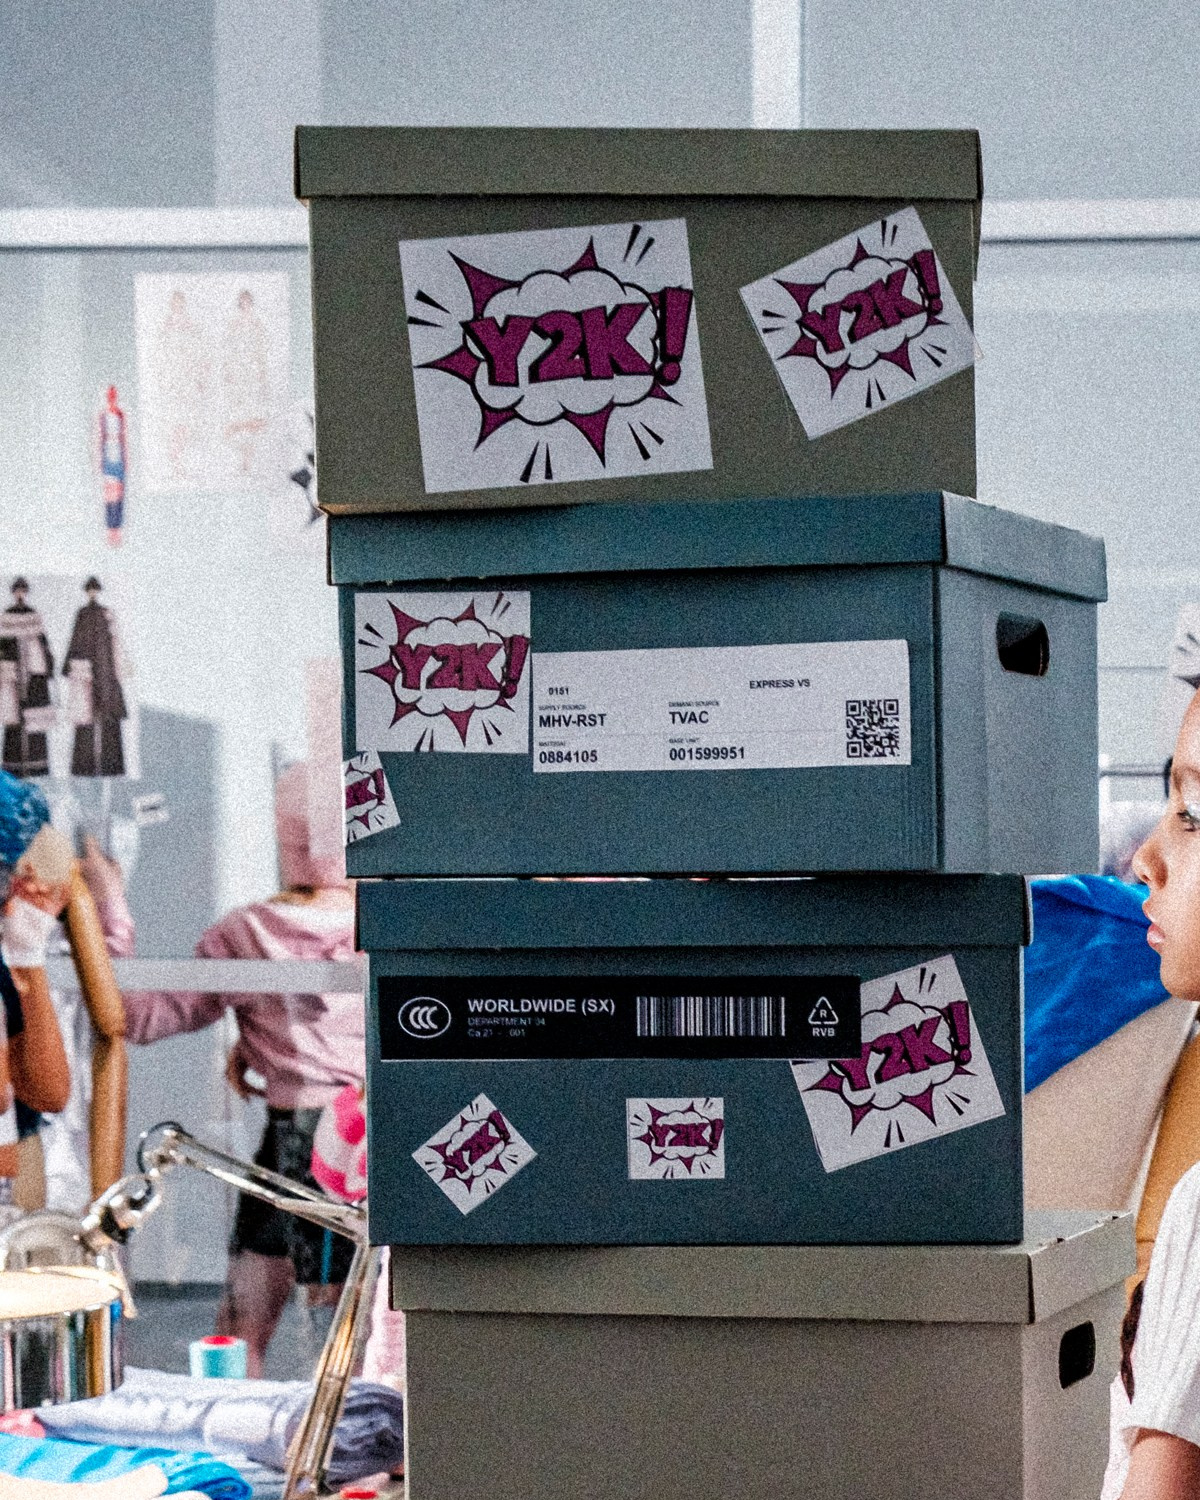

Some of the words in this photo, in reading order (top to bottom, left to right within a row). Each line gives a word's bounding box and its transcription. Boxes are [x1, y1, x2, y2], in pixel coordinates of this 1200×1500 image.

[796, 248, 944, 355] Y2K!
[459, 286, 694, 388] Y2K!
[388, 634, 530, 700] Y2K!
[749, 679, 795, 690] EXPRESS
[538, 713, 607, 728] MHV-RST
[669, 710, 709, 725] TVAC
[538, 749, 598, 764] 0884105
[669, 746, 745, 761] 001599951
[467, 999, 577, 1013] WORLDWIDE
[581, 998, 616, 1016] (SX)
[467, 1017, 532, 1026] DEPARTMENT
[812, 1027, 835, 1037] RVB
[829, 1000, 972, 1092] Y2K!
[648, 1118, 725, 1151] Y2K!
